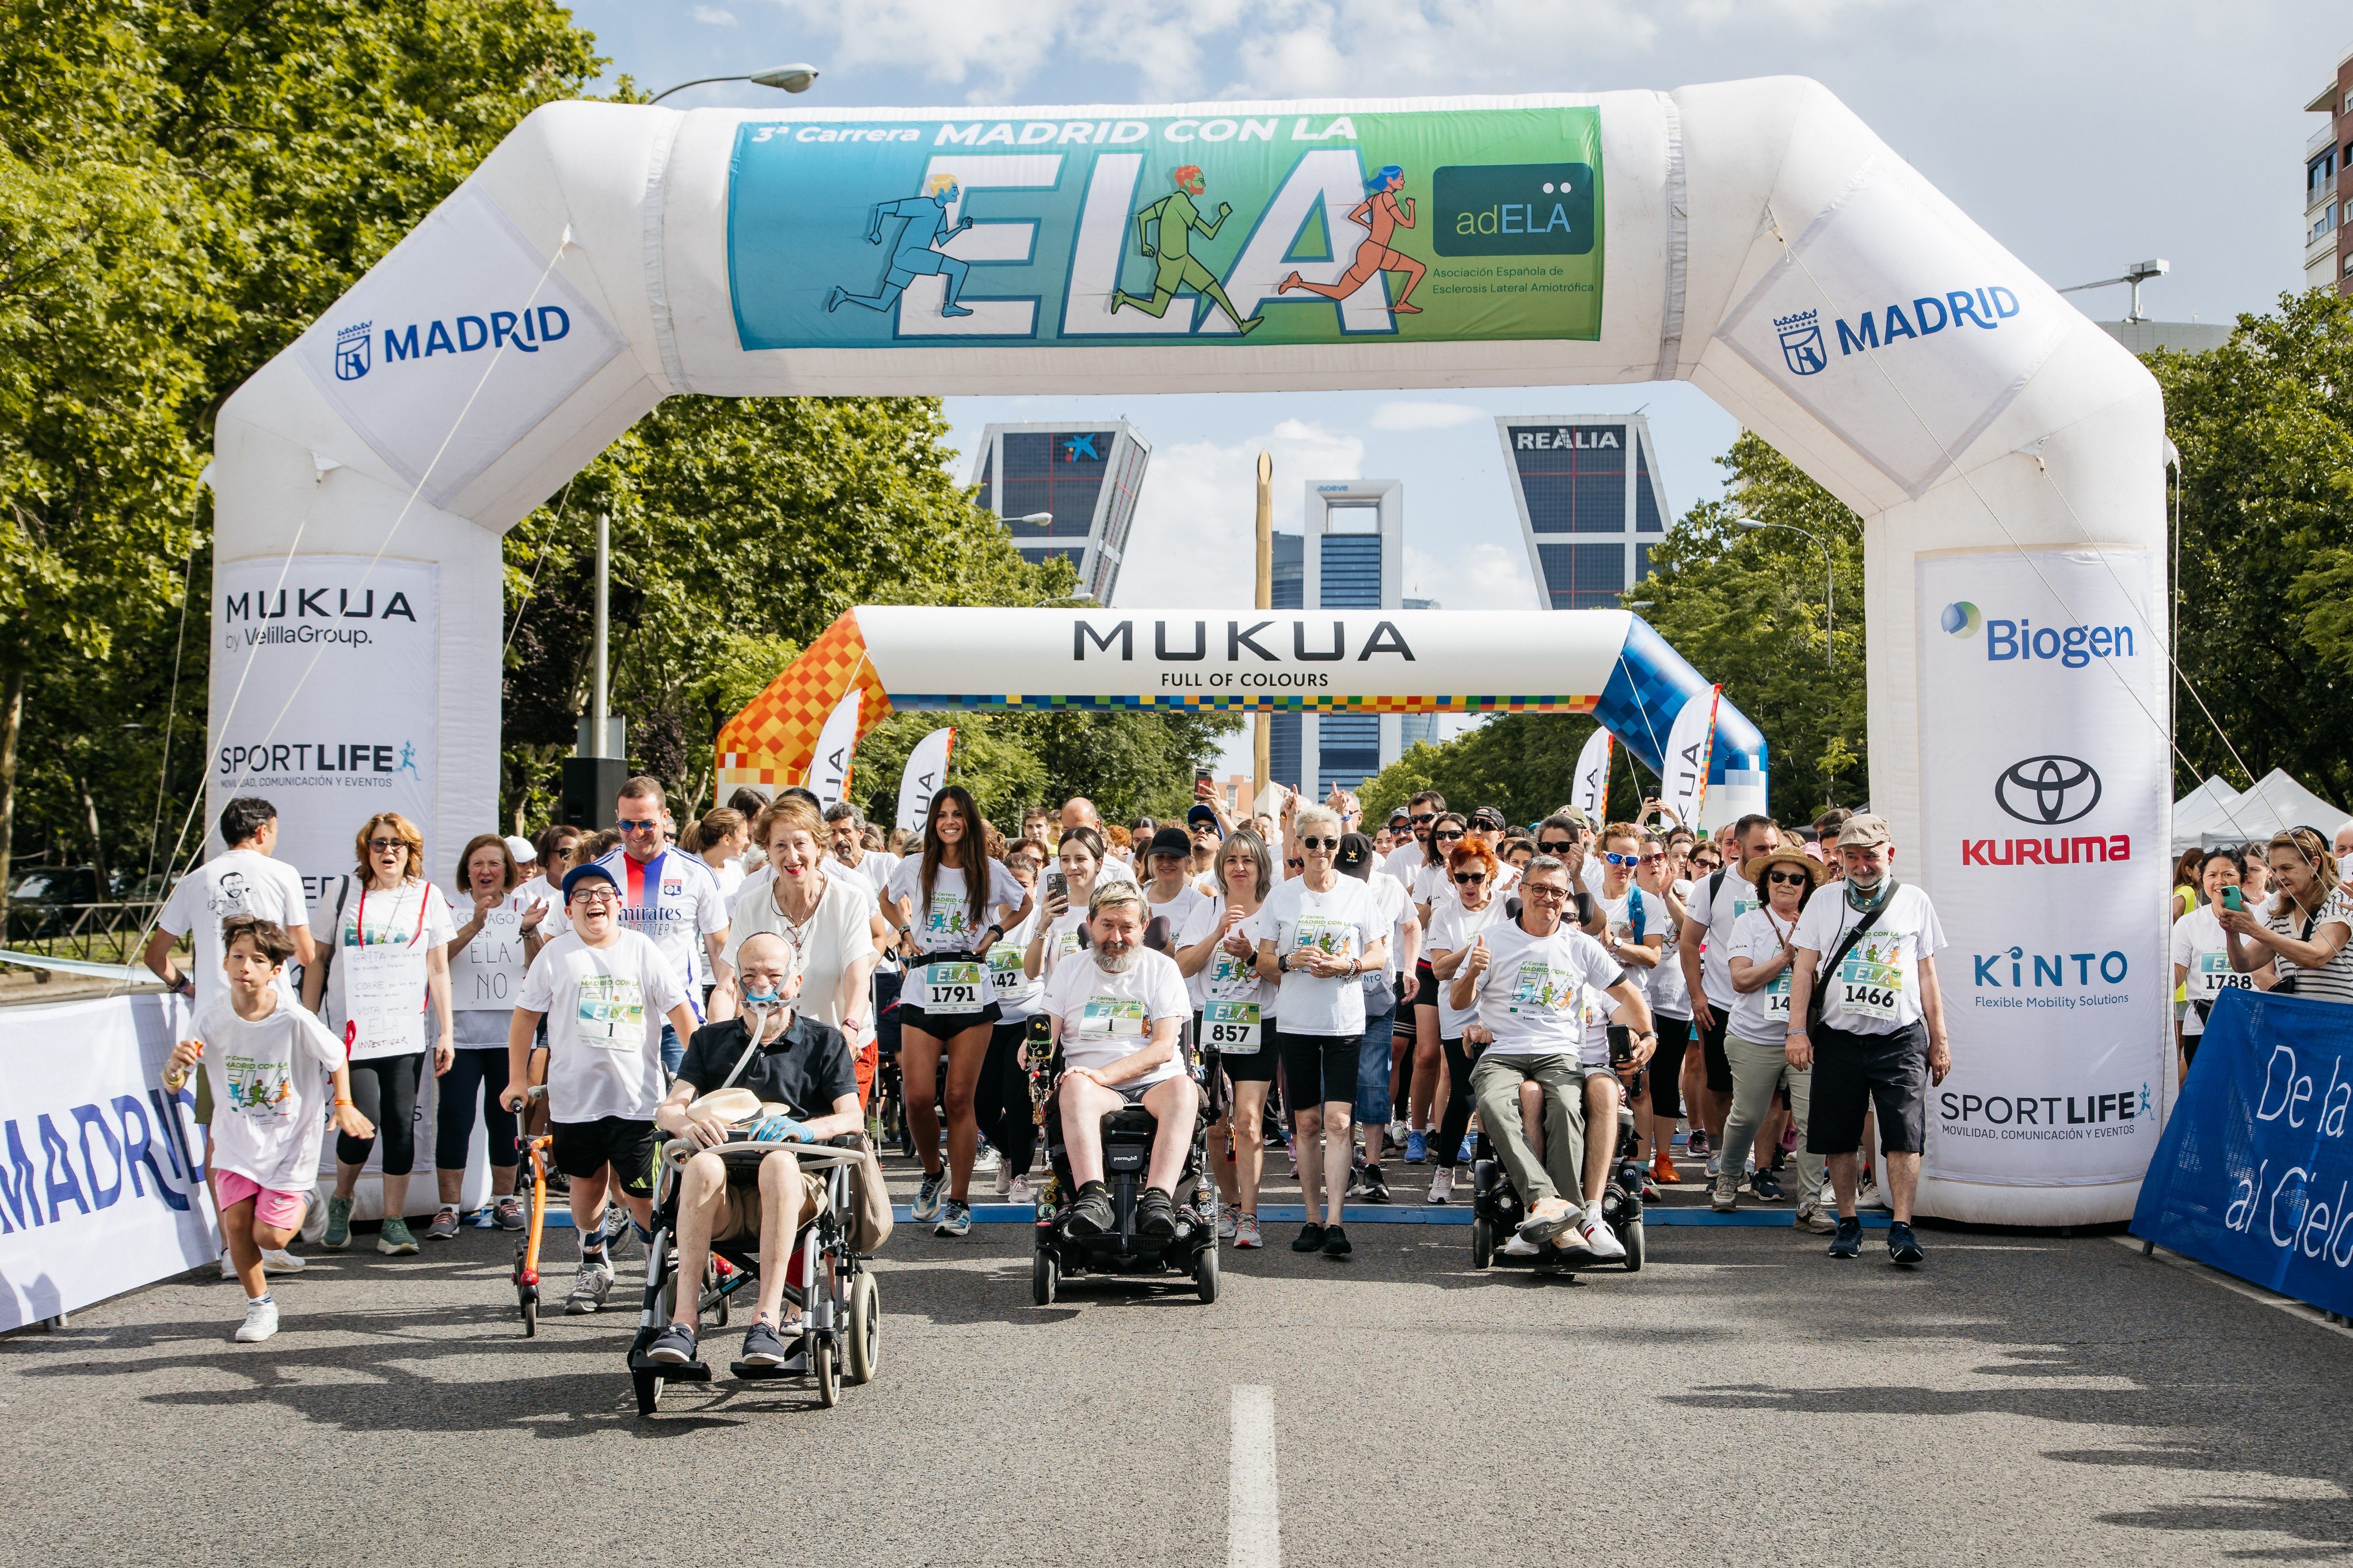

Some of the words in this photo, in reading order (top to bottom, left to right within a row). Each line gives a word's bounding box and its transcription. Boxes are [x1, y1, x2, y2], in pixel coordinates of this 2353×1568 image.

[751, 126, 790, 142] 3ª
[795, 126, 921, 143] Carrera
[934, 121, 1150, 146] MADRID
[1164, 119, 1272, 143] CON
[1290, 117, 1358, 140] LA
[892, 146, 1399, 339] ELA
[1433, 268, 1494, 277] Asociación
[1497, 266, 1547, 278] Española
[1549, 266, 1563, 276] de
[1433, 284, 1487, 293] Esclerosis
[1490, 283, 1528, 293] Lateral
[1530, 283, 1594, 292] Amiotrófica
[1835, 286, 2020, 356] MADRID
[384, 306, 570, 363] MADRID
[226, 588, 417, 623] MUKUA
[226, 631, 241, 652] by
[1073, 620, 1417, 662] MUKUA
[1988, 619, 2134, 668] Biogen
[1162, 673, 1202, 687] FULL
[1209, 673, 1233, 687] OF
[1240, 673, 1329, 687] COLOURS
[220, 744, 393, 774] SPORTLIFE
[259, 775, 333, 787] COMUNICACIÓN
[337, 777, 342, 786] Y
[345, 777, 393, 788] EVENTOS
[457, 913, 515, 925] COAGO
[353, 951, 386, 963] GRITA
[471, 942, 511, 963] ELA
[355, 981, 384, 990] CORRE
[477, 972, 507, 999] NO
[2206, 975, 2252, 989] 1788
[932, 986, 976, 1003] 1791
[1845, 985, 1894, 1008] 1466
[1975, 996, 2023, 1008] Flexible
[2027, 996, 2076, 1009] Mobility
[2080, 994, 2129, 1006] Solutions
[357, 1006, 380, 1016] VOTA
[1214, 1005, 1248, 1021] ELA
[368, 1017, 399, 1036] ELA
[608, 1023, 614, 1037] 1
[1107, 1018, 1114, 1032] 1
[1212, 1024, 1251, 1043] 857
[358, 1036, 408, 1049] INVESTIGAR
[2256, 1045, 2313, 1128] De
[2317, 1055, 2351, 1138] la
[1940, 1091, 2135, 1125] SPORTLIFE
[1942, 1124, 1998, 1141] MOVILIDAD,
[2002, 1128, 2083, 1140] COMUNICACIÓN
[2087, 1129, 2093, 1139] Y
[2095, 1124, 2135, 1139] EVENTOS
[0, 1088, 207, 1234] MADRID
[2226, 1159, 2268, 1234] al
[2271, 1167, 2353, 1268] Cielo
